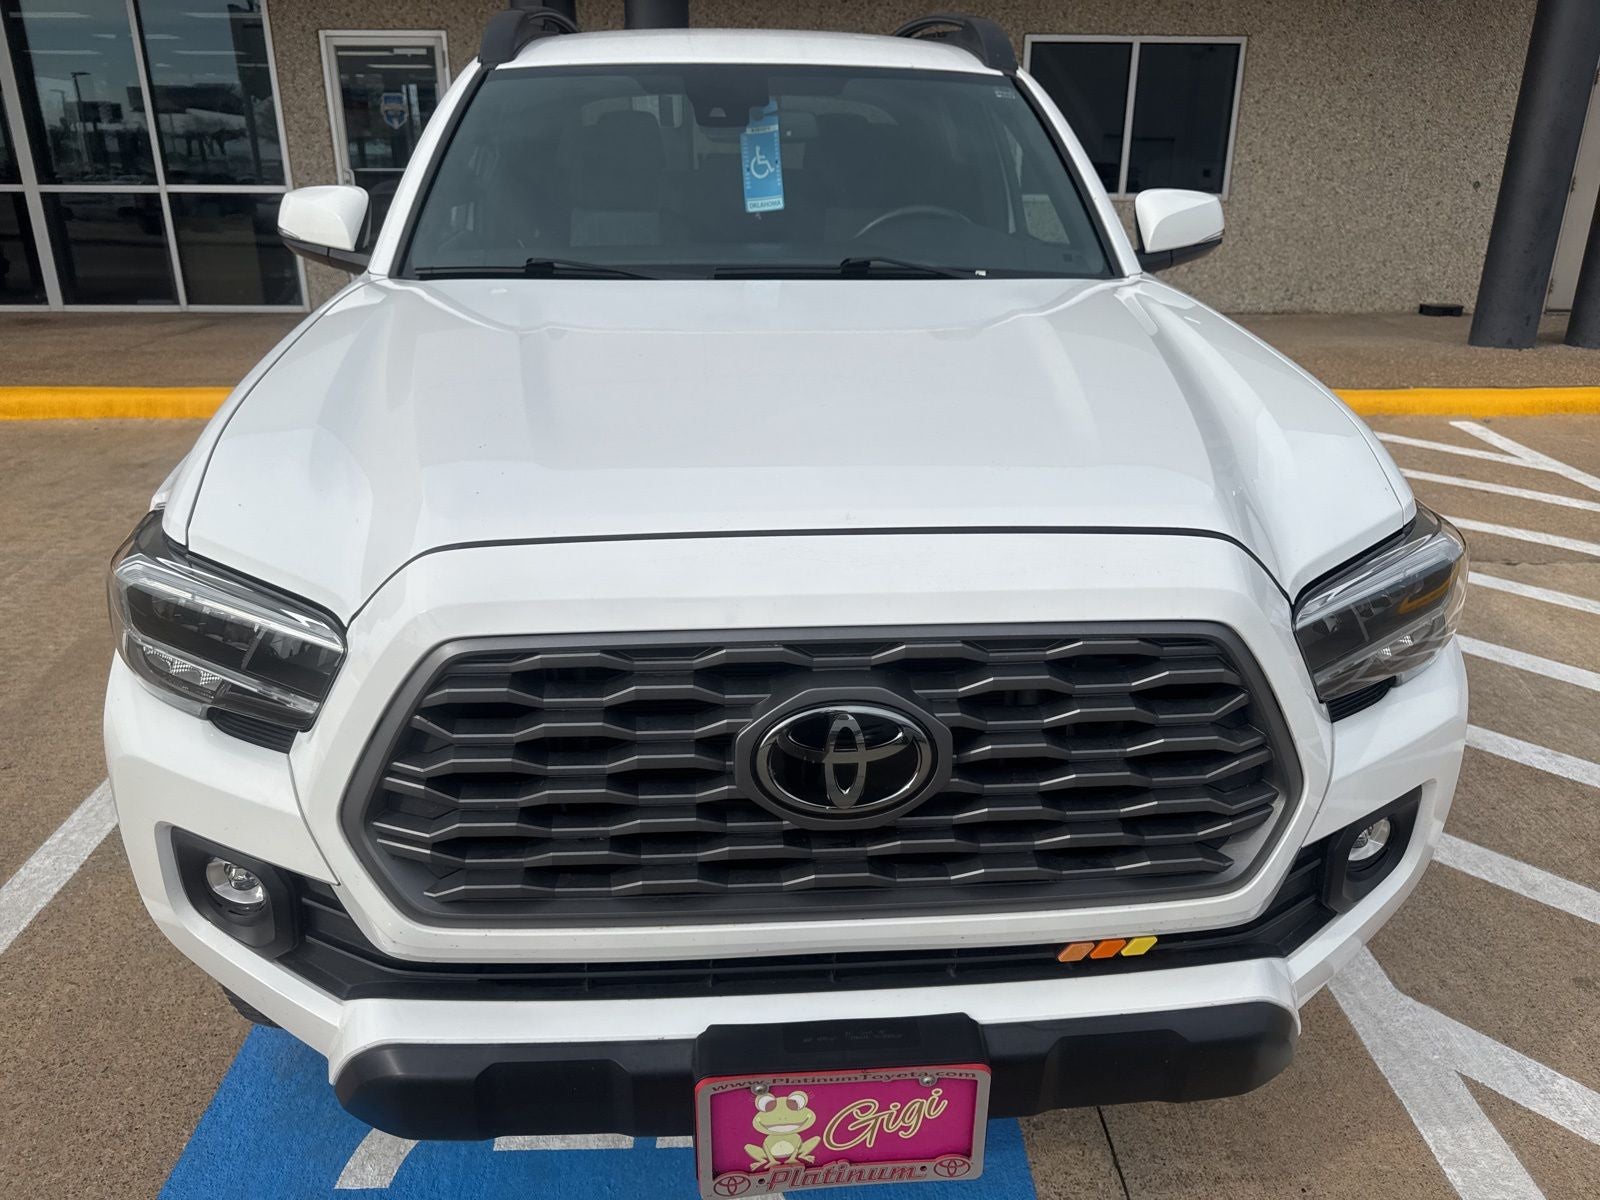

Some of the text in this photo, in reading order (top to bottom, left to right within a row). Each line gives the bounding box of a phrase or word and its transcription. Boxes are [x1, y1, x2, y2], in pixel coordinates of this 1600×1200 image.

[749, 200, 782, 210] OKLAHOMA
[711, 1071, 977, 1092] www.PlatinumToyota.com
[822, 1088, 948, 1151] Gigi
[767, 1162, 918, 1191] Platinum
